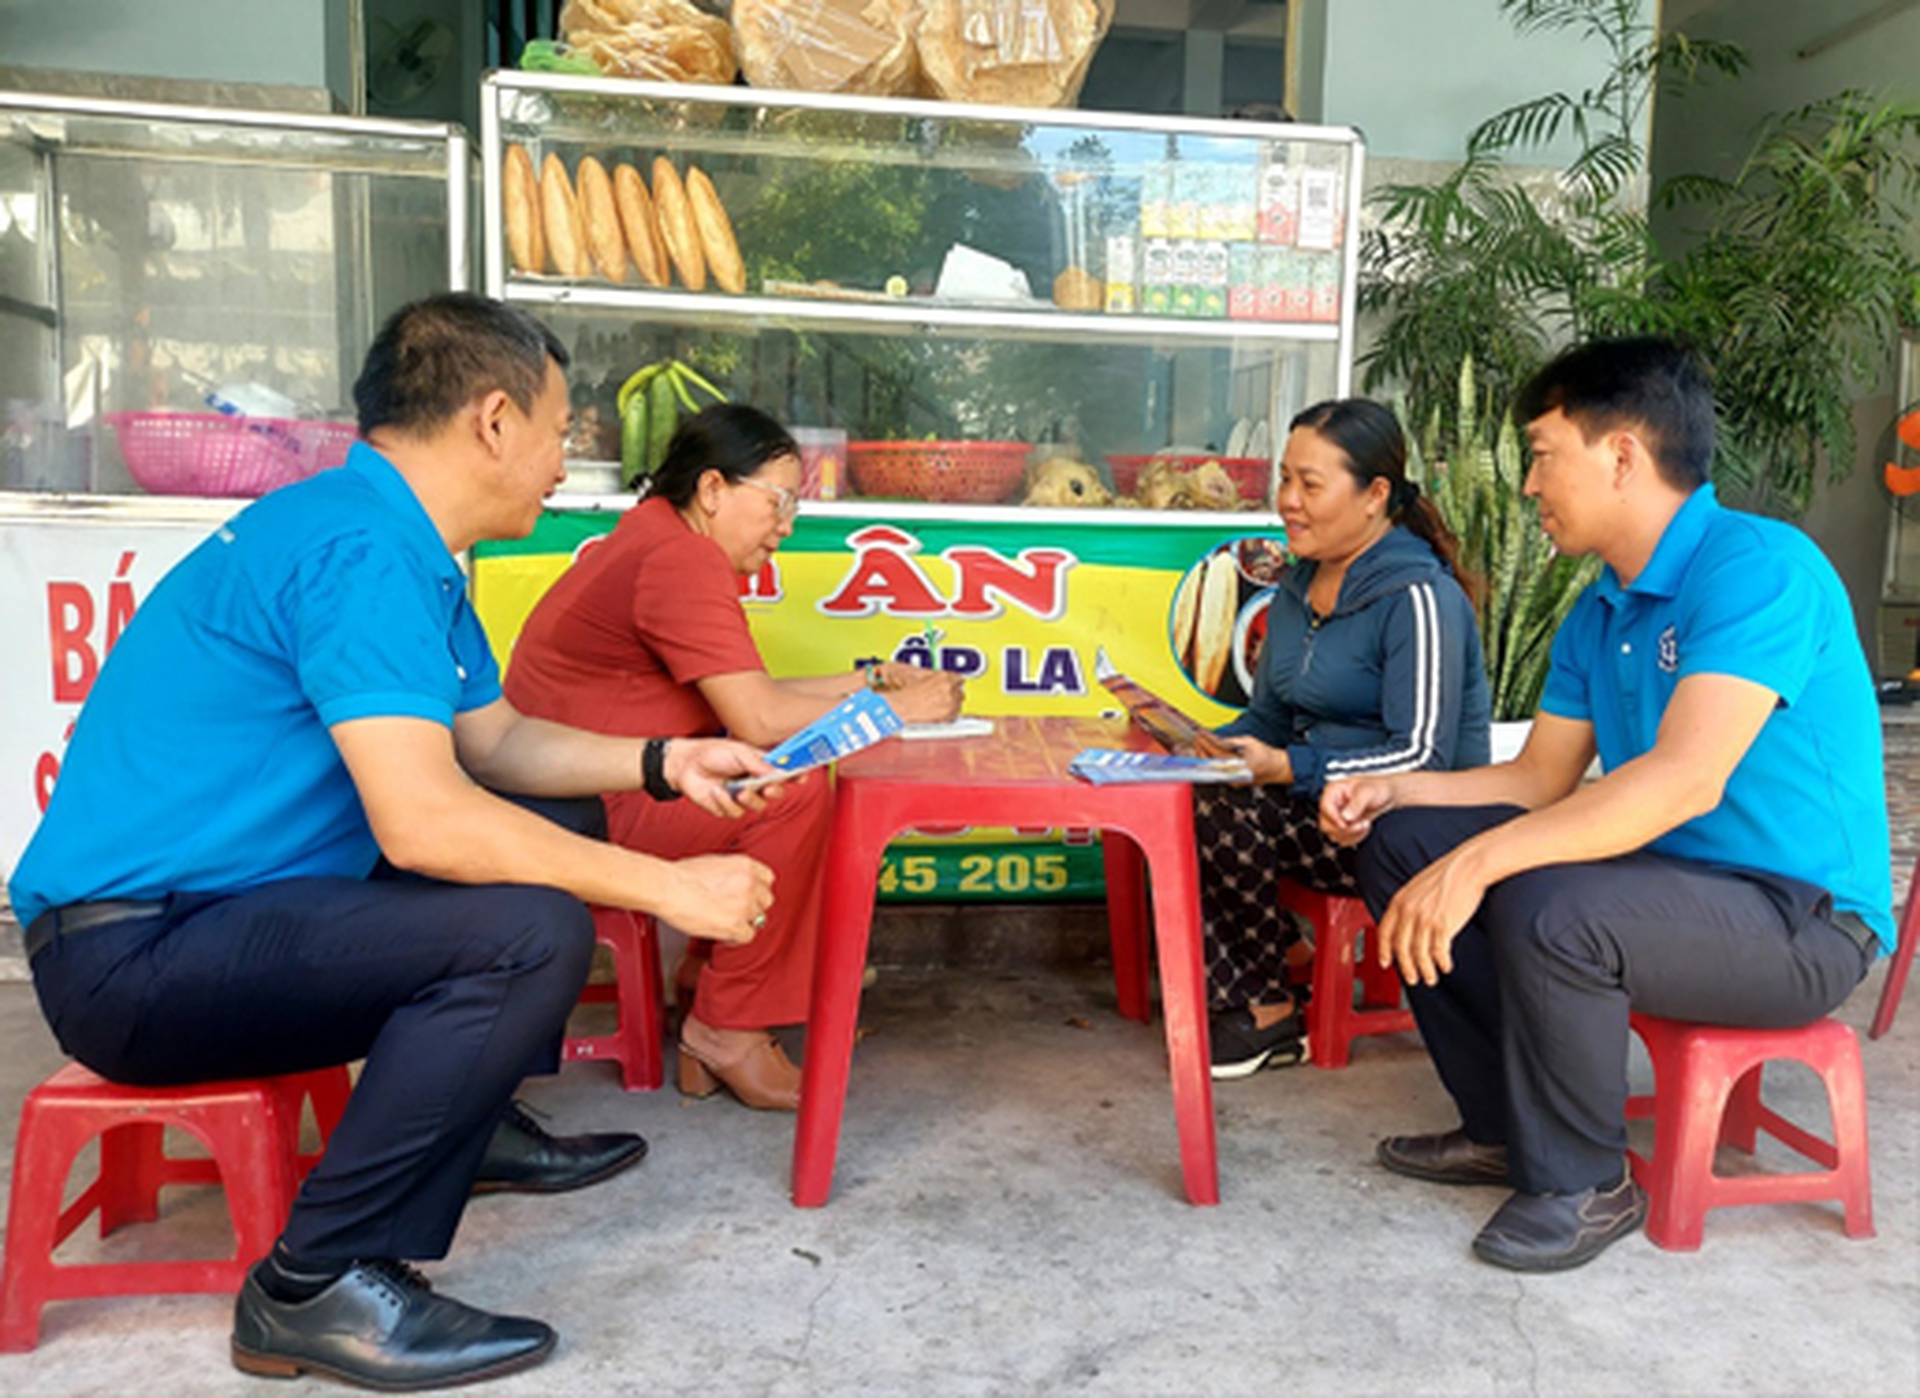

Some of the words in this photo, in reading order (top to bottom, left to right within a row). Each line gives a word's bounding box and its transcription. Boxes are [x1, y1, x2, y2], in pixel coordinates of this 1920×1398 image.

[820, 526, 1073, 617] ÂN
[1003, 647, 1082, 693] LA
[958, 855, 1068, 893] 205
